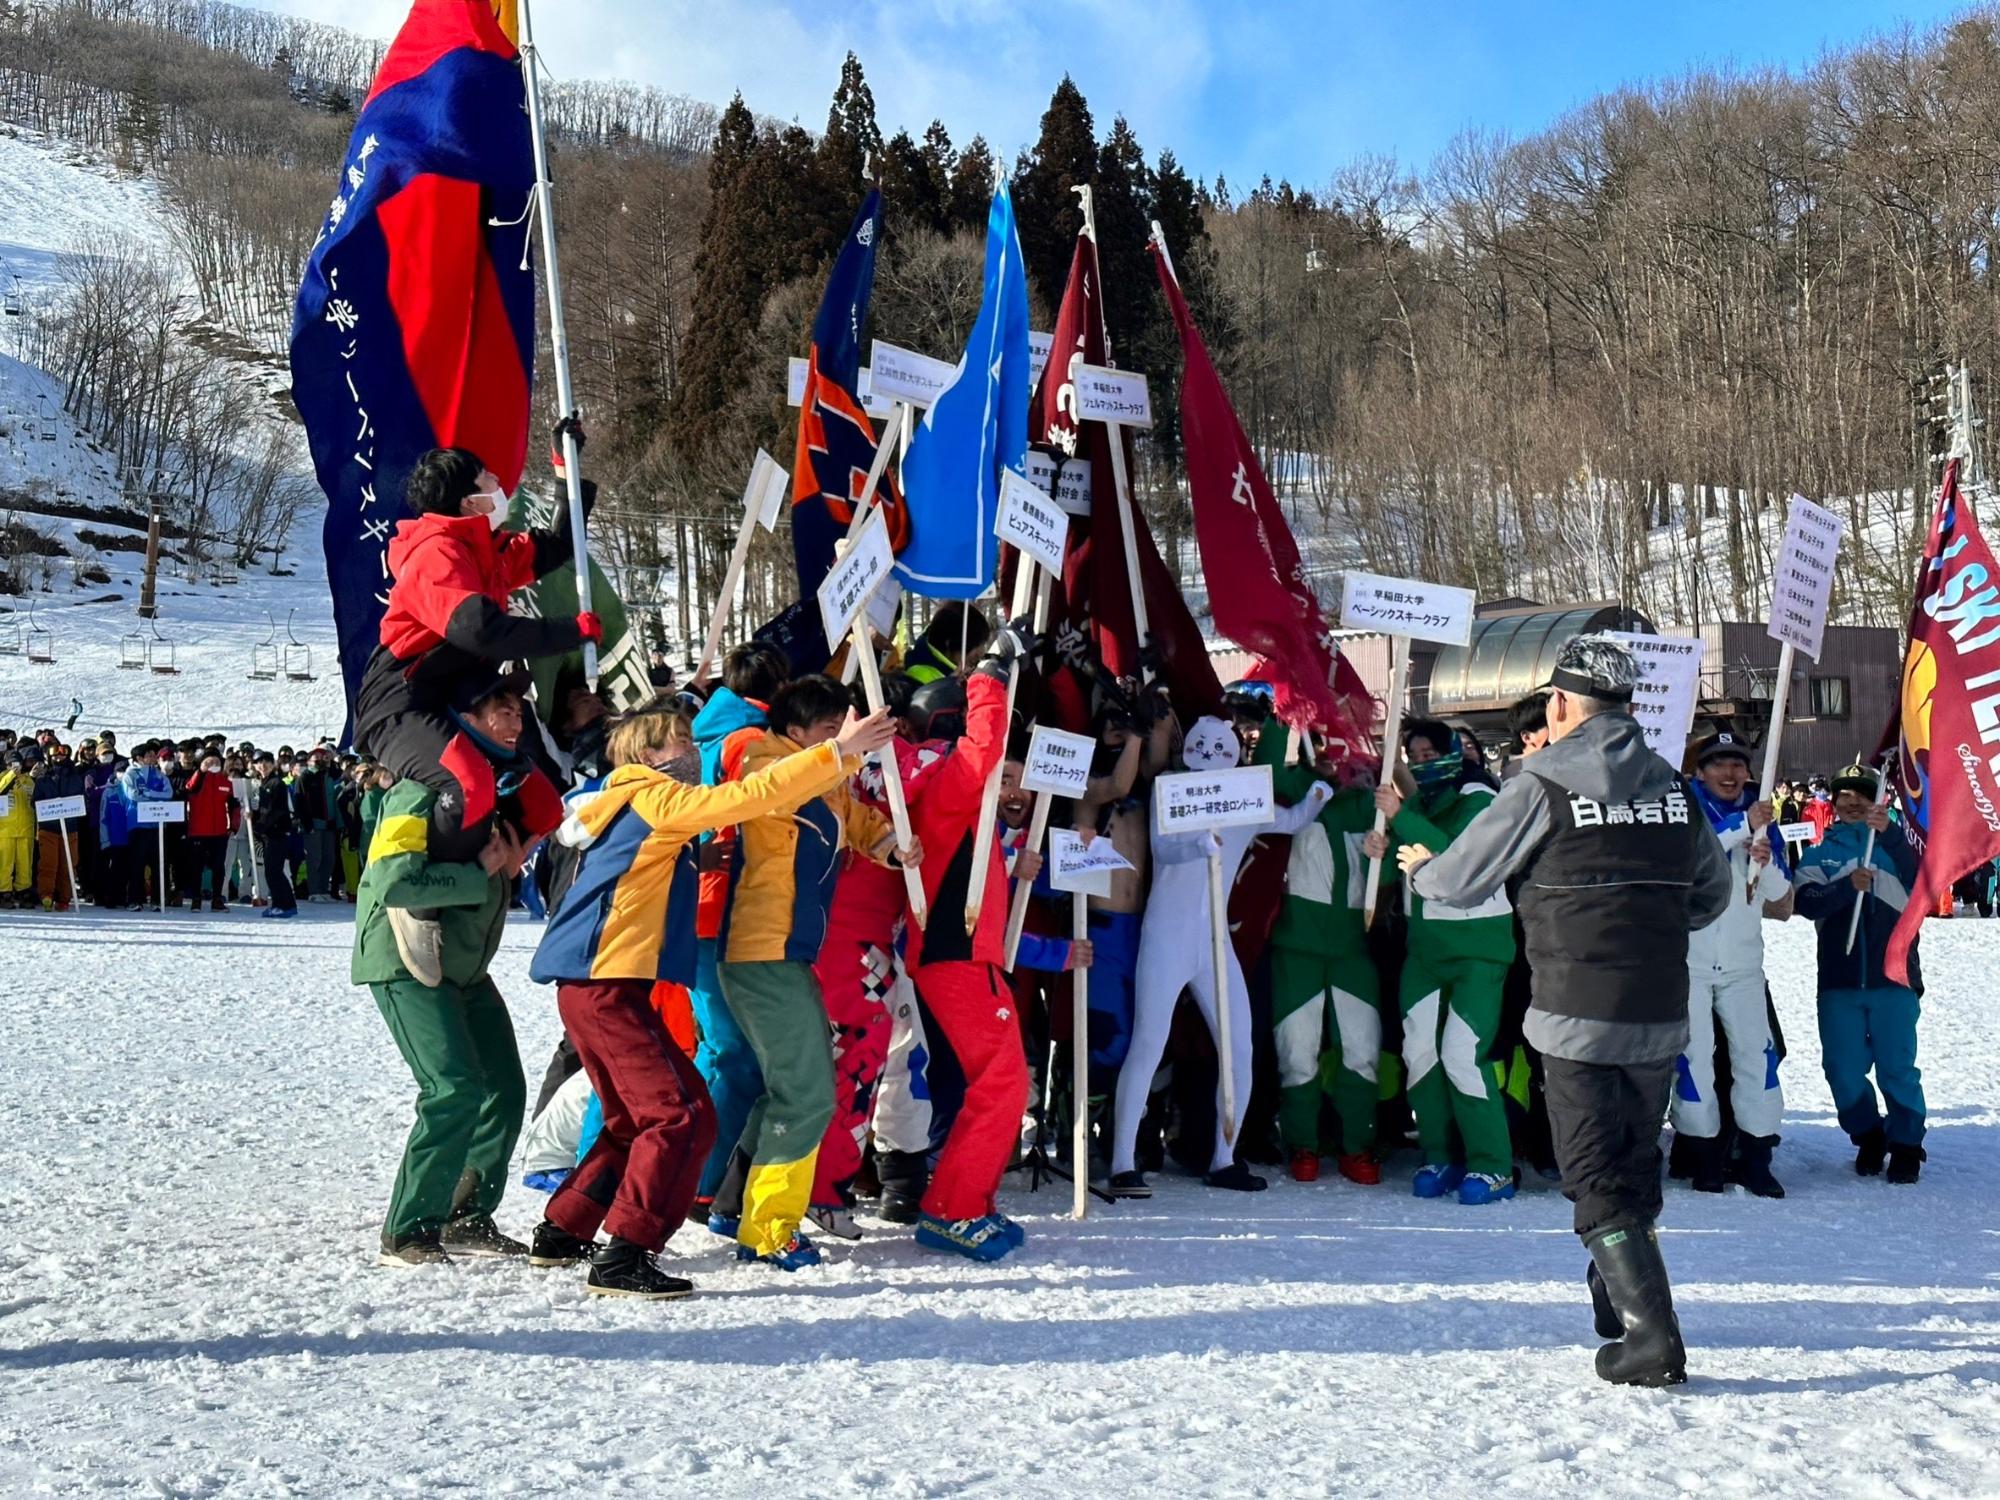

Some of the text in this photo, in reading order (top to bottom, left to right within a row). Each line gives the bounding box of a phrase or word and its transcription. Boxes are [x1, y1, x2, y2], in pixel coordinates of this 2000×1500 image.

[1374, 589, 1425, 605] 早稲田大学
[1352, 604, 1451, 627] ベーシックスキークラブ
[1185, 784, 1222, 798] 明治大学
[1169, 797, 1264, 819] 基礎スキー研究会ロンドール
[1570, 793, 1689, 828] 白馬岩岳
